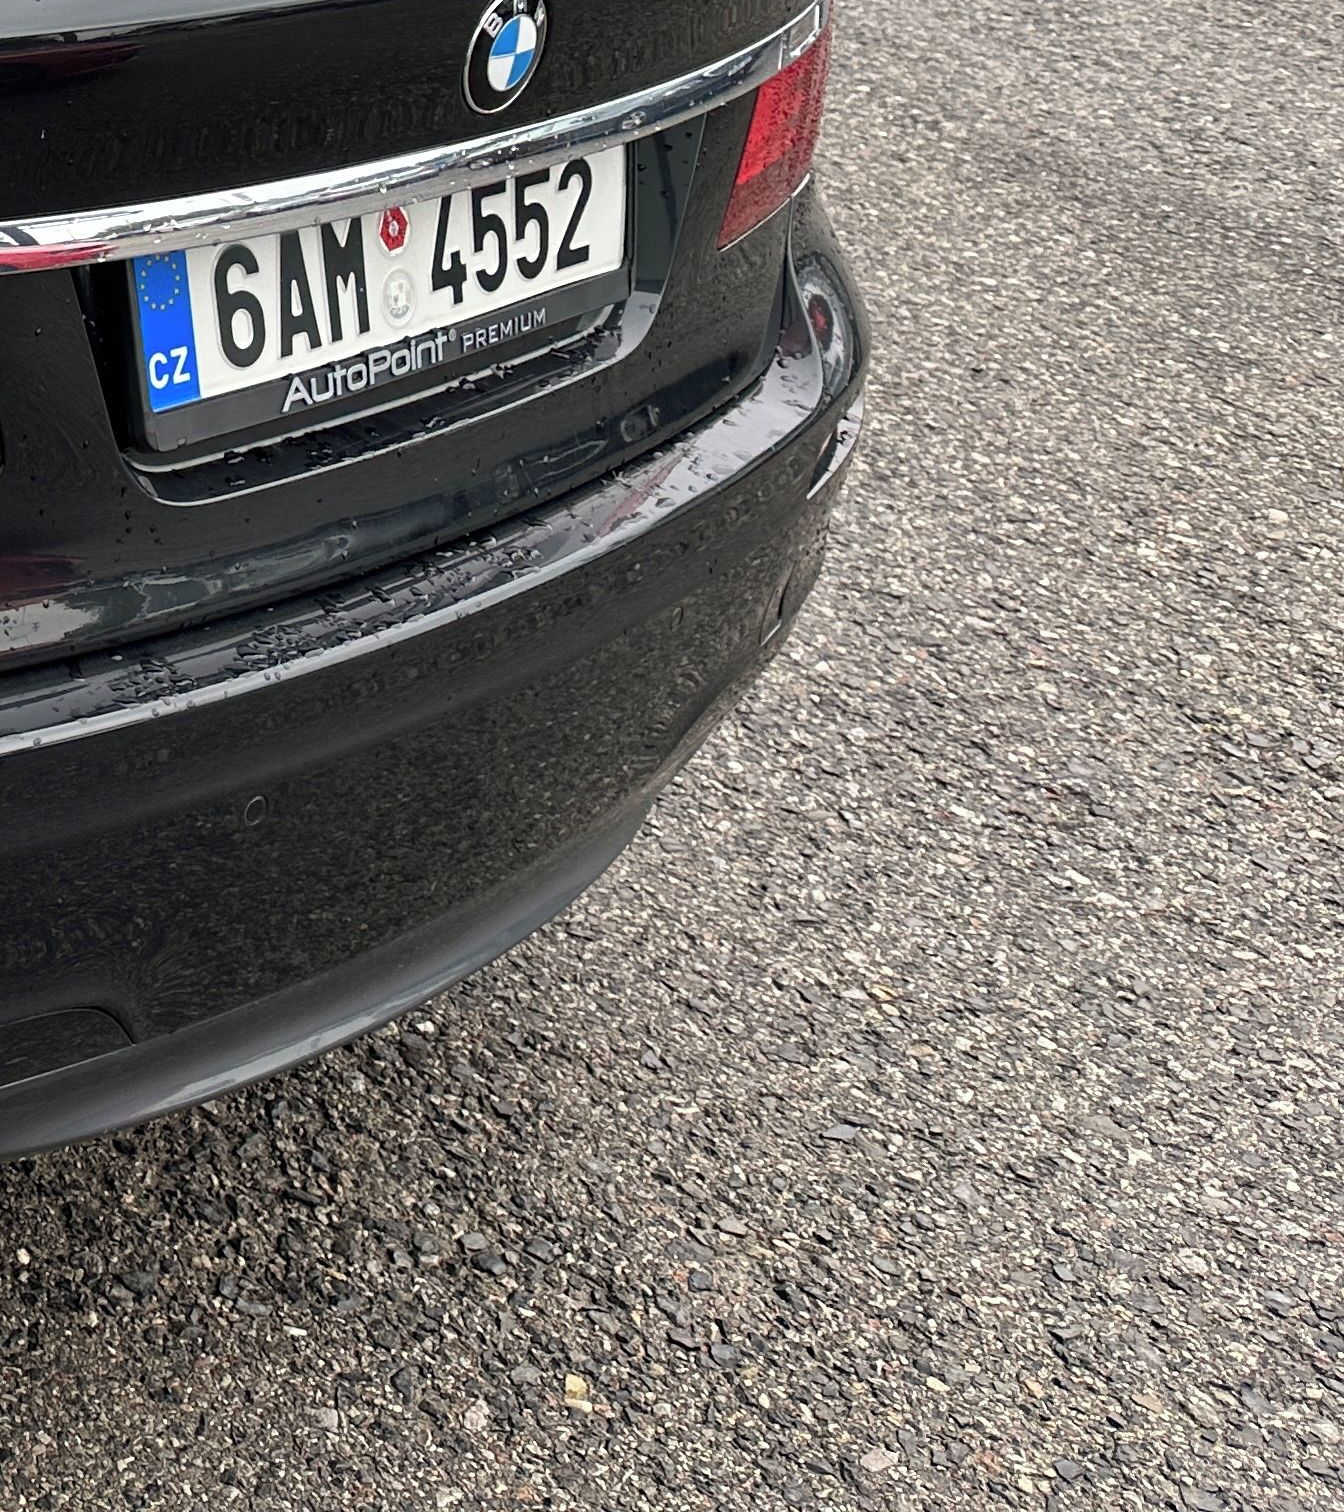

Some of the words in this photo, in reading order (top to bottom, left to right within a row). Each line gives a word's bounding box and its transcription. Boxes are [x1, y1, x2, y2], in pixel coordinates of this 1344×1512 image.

[214, 217, 371, 368] 6AM
[431, 159, 593, 306] 4552
[461, 305, 547, 355] PREMIUM
[148, 346, 192, 390] CZ
